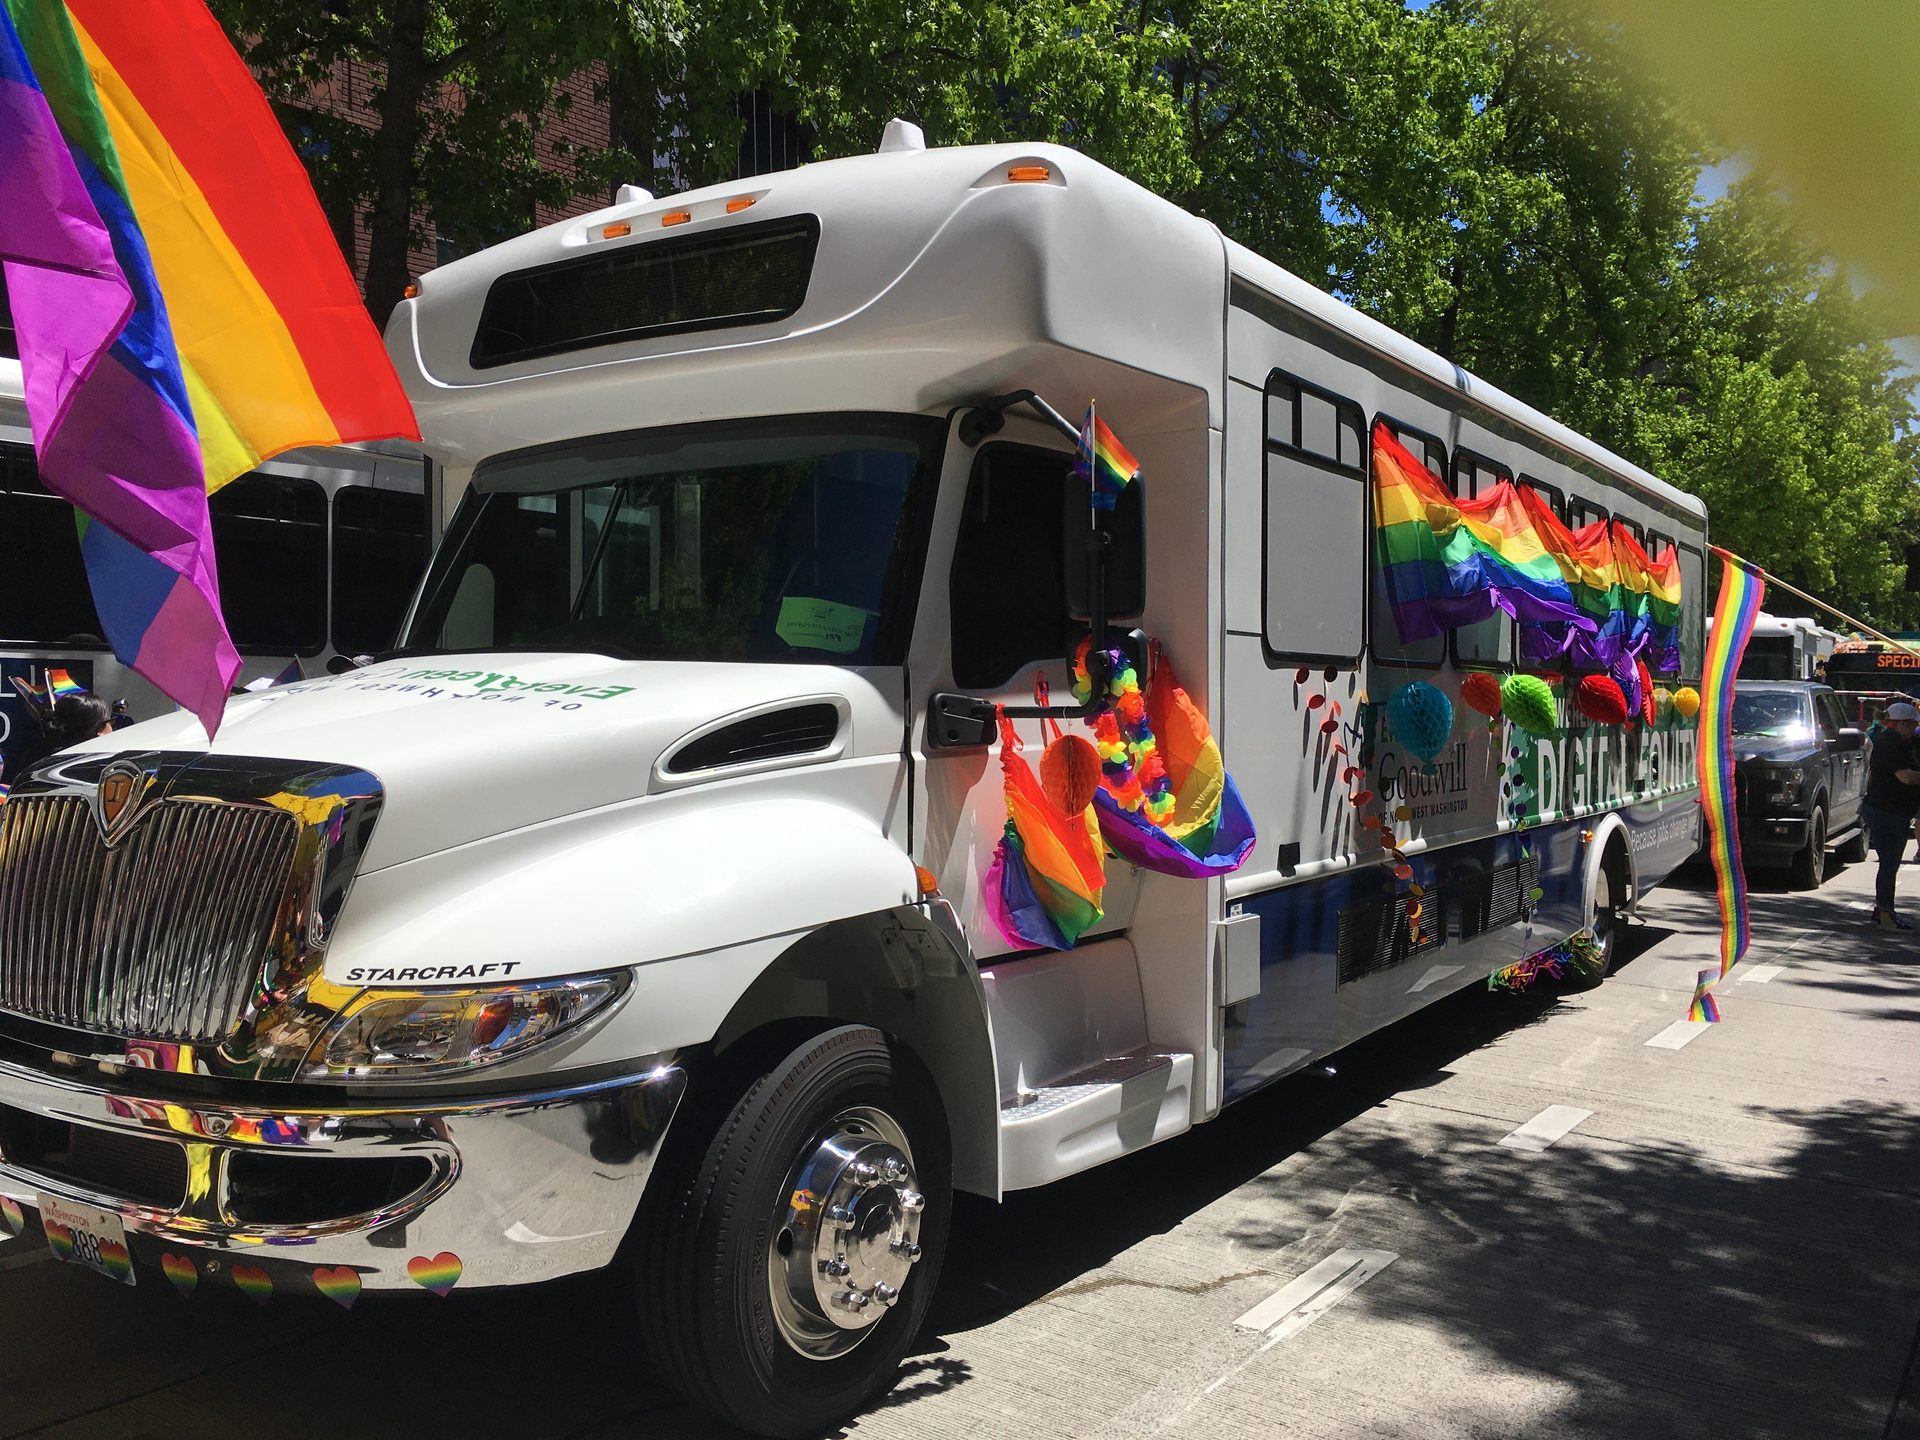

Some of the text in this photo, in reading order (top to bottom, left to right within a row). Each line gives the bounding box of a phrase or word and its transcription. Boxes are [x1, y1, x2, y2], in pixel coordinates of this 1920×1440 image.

[1877, 654, 1920, 668] SPECI
[1380, 742, 1468, 802] Goodwill
[1538, 729, 1700, 823] DIGITAL EQUITY
[1389, 804, 1428, 823] NWEST
[1430, 799, 1468, 816] WASHINGTON
[1631, 828, 1657, 852] Because
[1657, 821, 1669, 849] jobs
[346, 961, 521, 981] STARCRAFT
[44, 1205, 90, 1228] WASHINGTON
